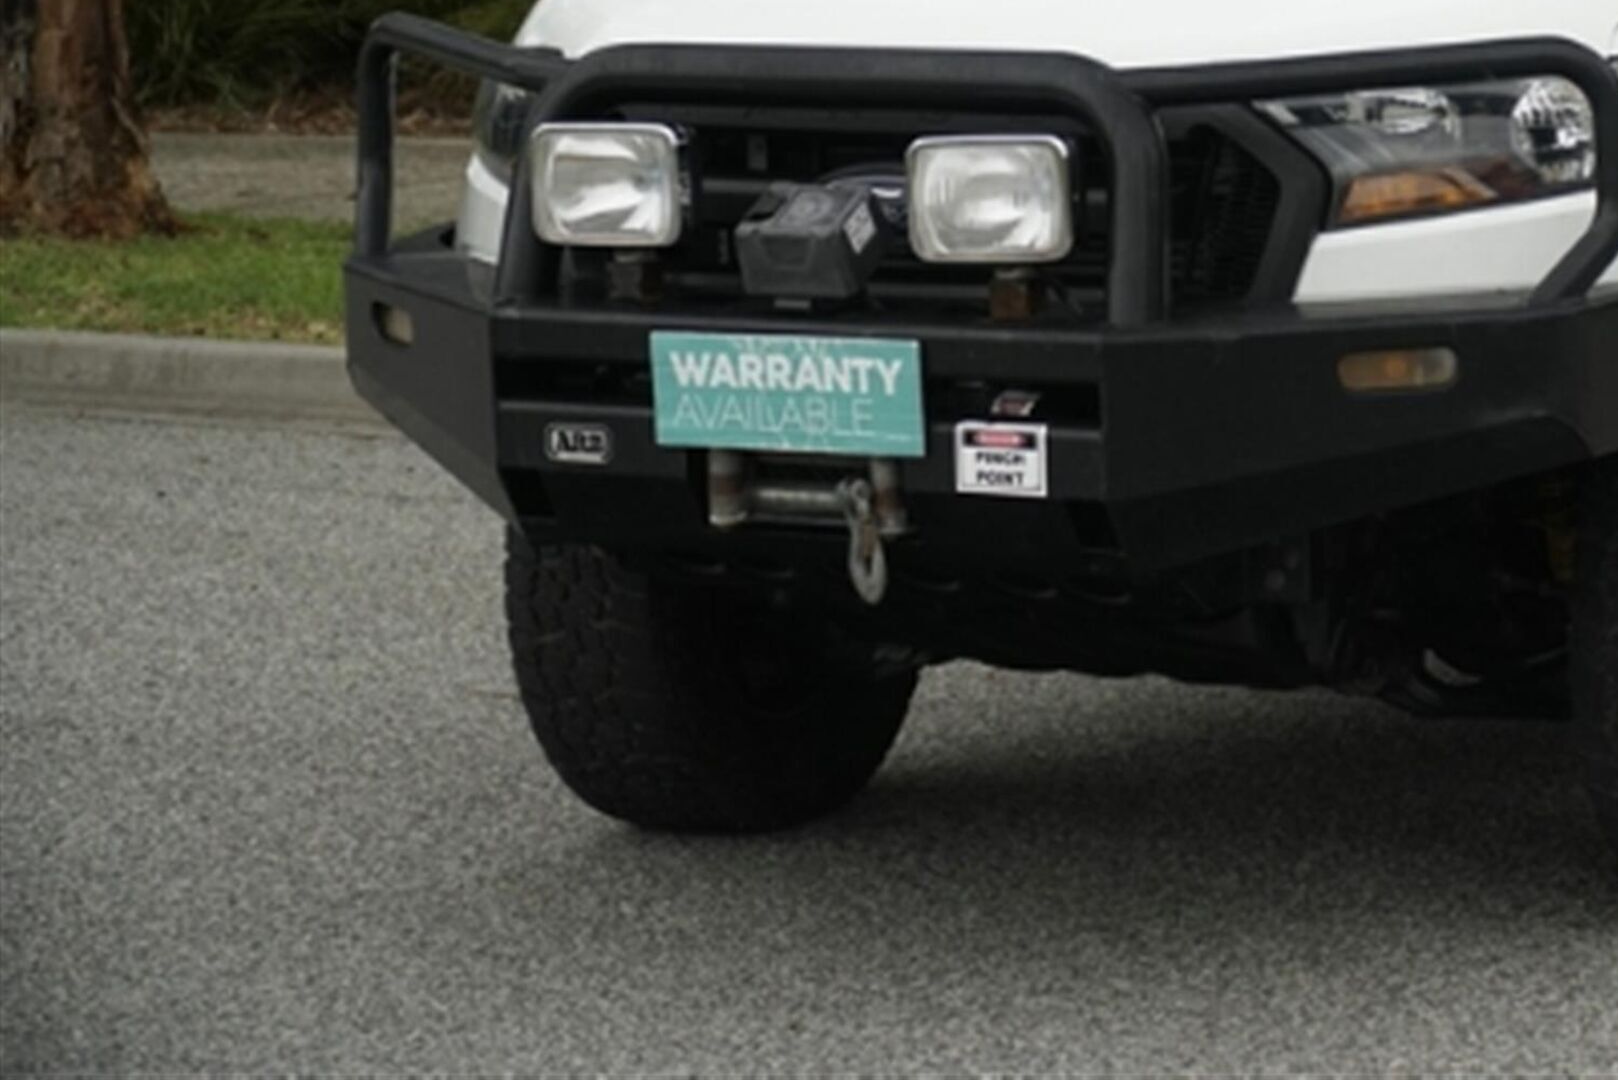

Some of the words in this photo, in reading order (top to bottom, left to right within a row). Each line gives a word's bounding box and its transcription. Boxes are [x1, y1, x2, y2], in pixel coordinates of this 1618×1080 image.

[669, 350, 902, 397] WARRANTY
[673, 393, 875, 436] AVAILABLE
[976, 469, 1025, 485] POINT
